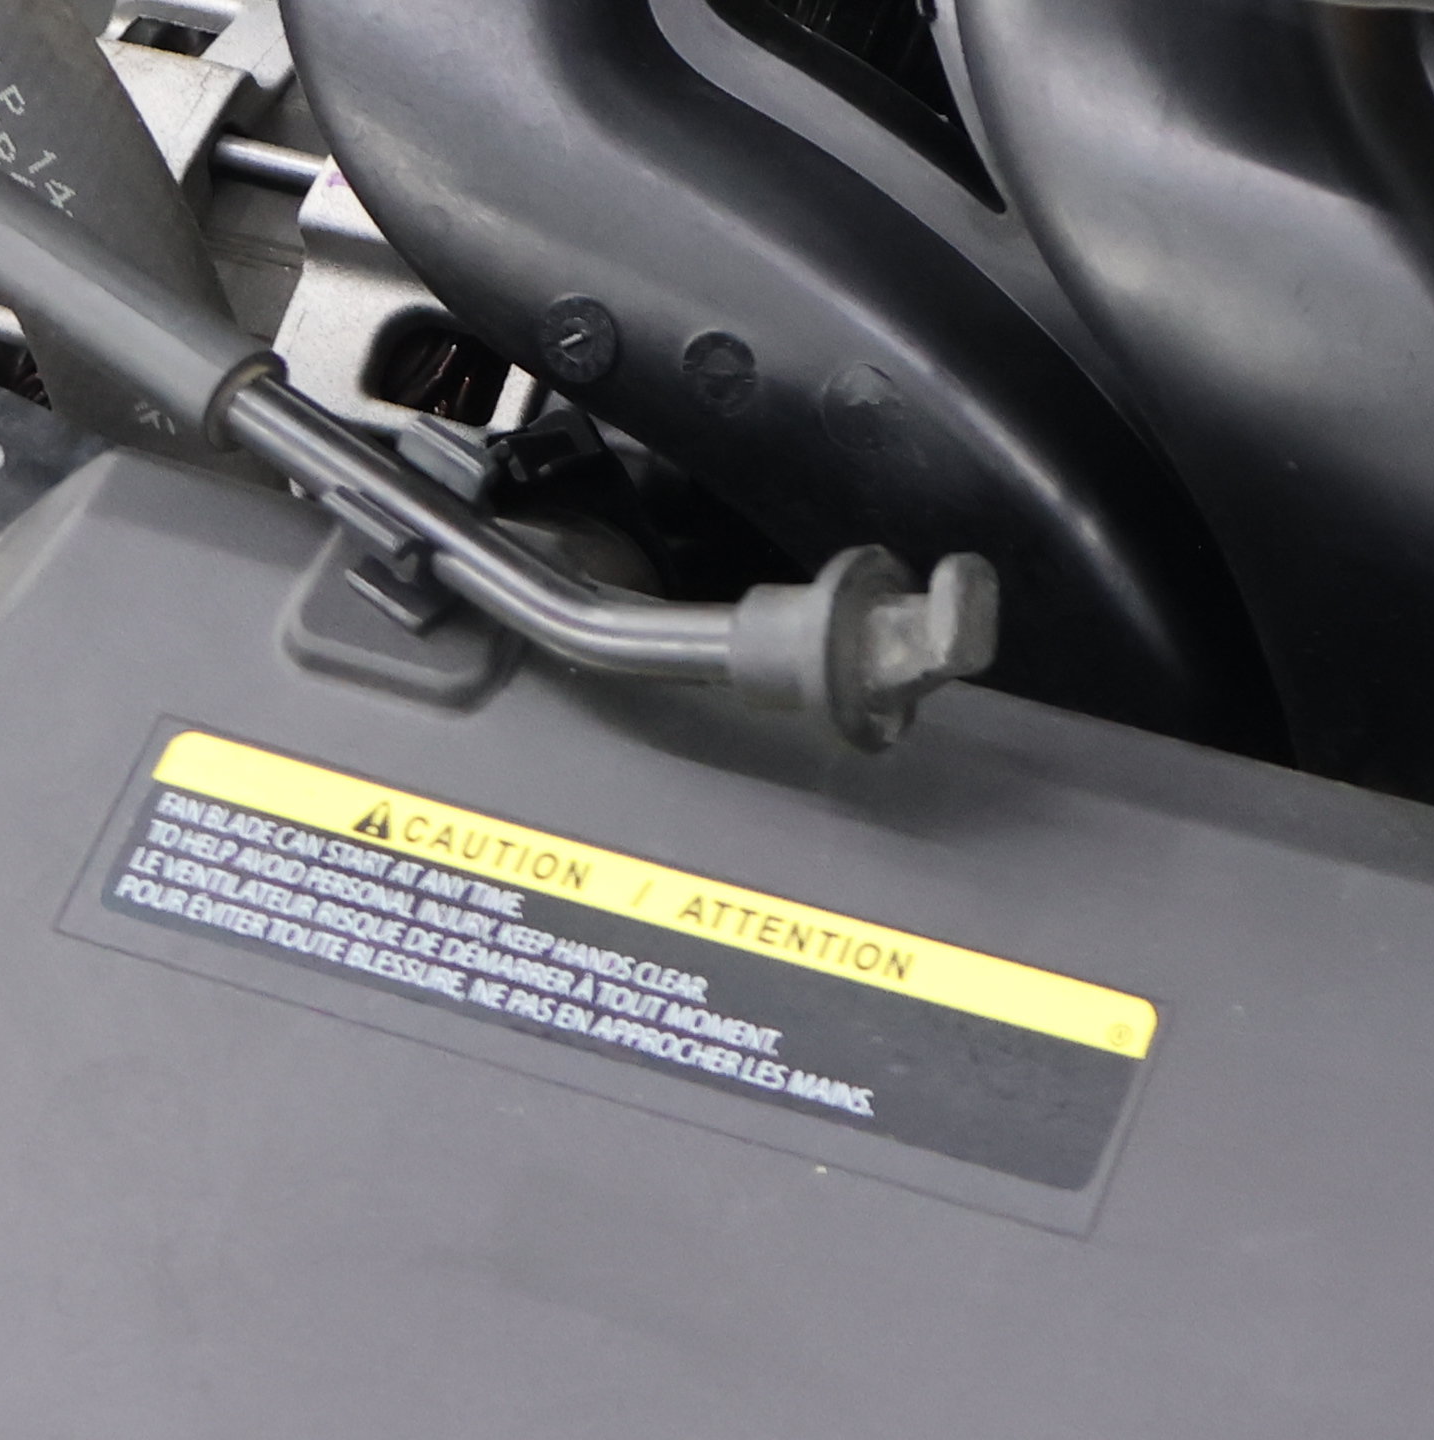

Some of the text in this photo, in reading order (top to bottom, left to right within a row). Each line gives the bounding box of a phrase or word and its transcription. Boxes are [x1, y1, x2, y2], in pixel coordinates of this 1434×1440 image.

[141, 820, 182, 849] TO
[175, 830, 239, 865] HELP
[232, 846, 308, 885] AVOID
[301, 866, 421, 918] PERSONAL
[414, 898, 501, 941] INJURY,
[494, 921, 557, 957] KEEP
[549, 937, 637, 980] HANDS
[155, 792, 206, 823] FAN
[200, 805, 278, 844] BLADE
[271, 825, 329, 859] CAN
[321, 840, 394, 877] START
[388, 859, 424, 886] AT
[401, 815, 592, 891] CAUTION
[677, 892, 915, 983] ATTENTION
[112, 875, 188, 915] POUR
[182, 892, 273, 939] ÉVITER
[263, 918, 351, 962] TOUTE
[343, 941, 474, 998] BLESSURE,
[466, 977, 510, 1008] NE
[503, 987, 558, 1022] PAS
[550, 1001, 596, 1033] EN
[589, 1012, 746, 1076] APPROCHER
[738, 1055, 792, 1089] LES
[127, 847, 164, 875] LE
[157, 856, 319, 920] VENTILATEUR
[312, 900, 407, 945] RISQUE
[401, 926, 446, 956] DE
[438, 934, 579, 995] DÉMARRER
[592, 981, 668, 1020] TOUT
